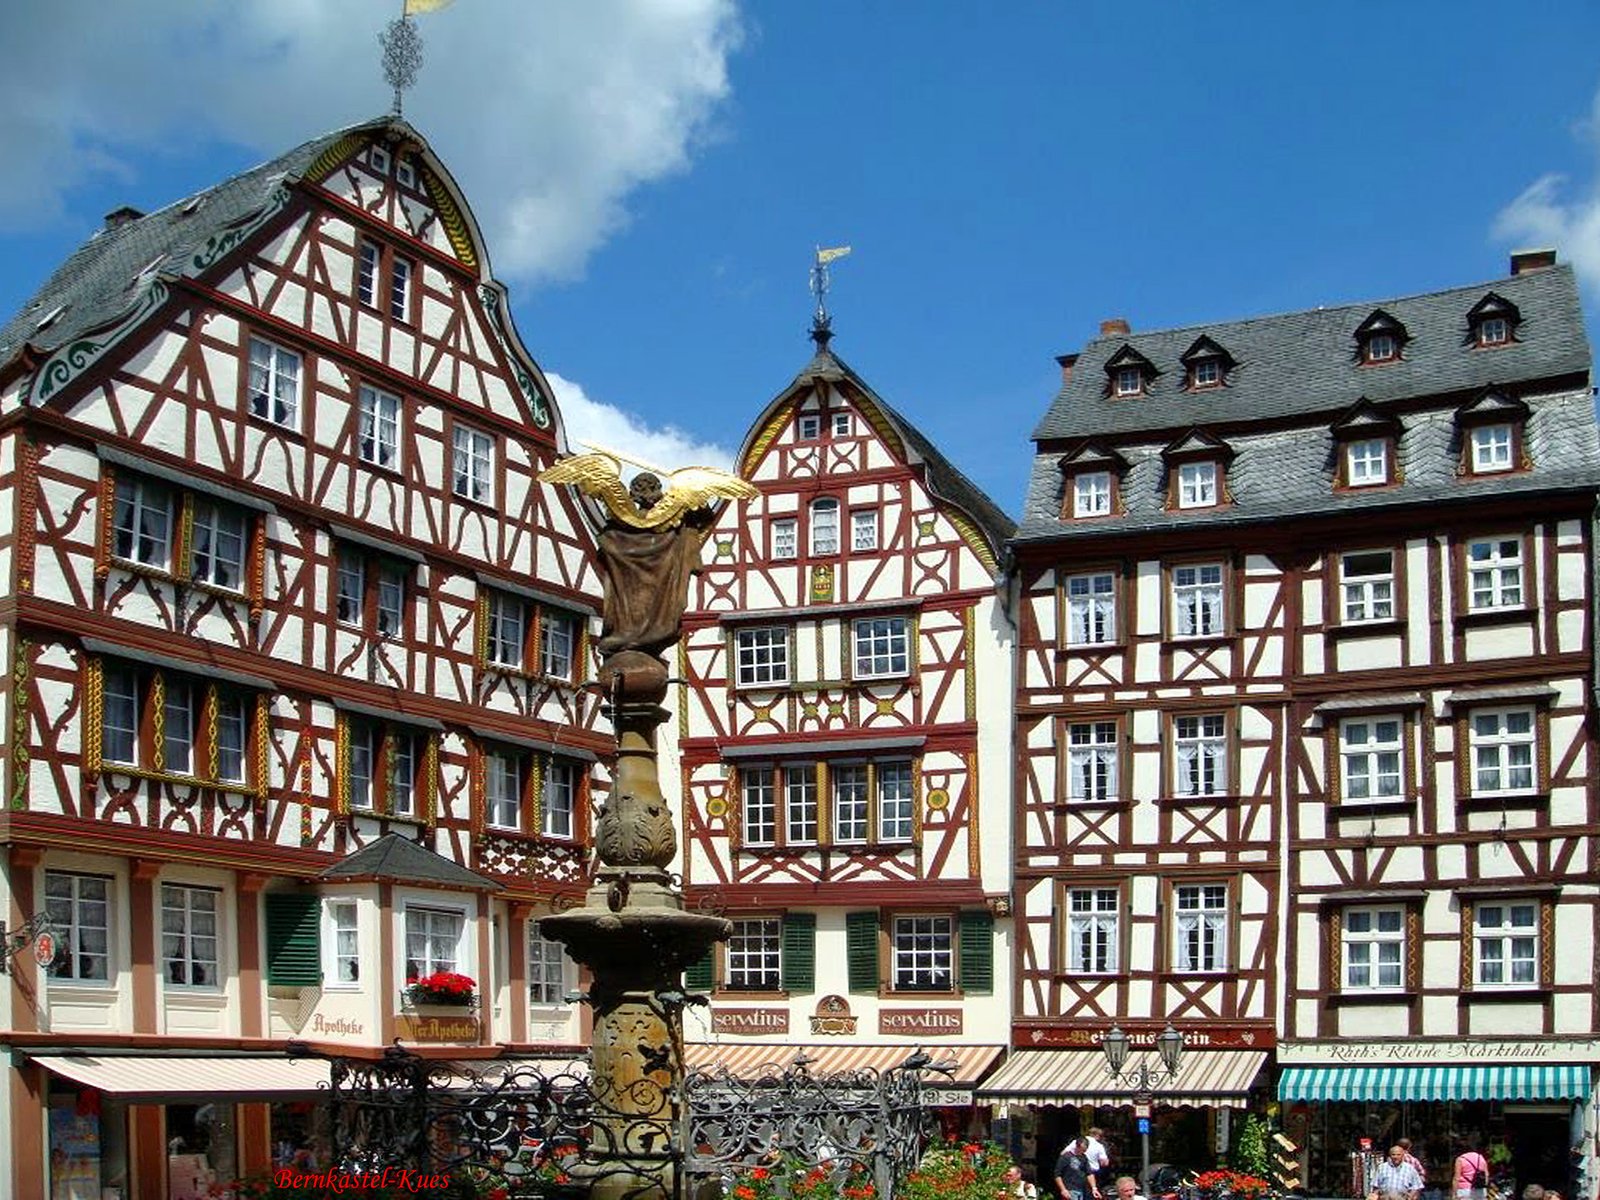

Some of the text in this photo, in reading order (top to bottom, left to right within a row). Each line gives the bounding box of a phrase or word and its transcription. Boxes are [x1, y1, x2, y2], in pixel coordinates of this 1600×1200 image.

[312, 1013, 363, 1036] Apotheke
[881, 1010, 961, 1027] servatius
[1448, 1043, 1550, 1058] Markthalle
[945, 1092, 969, 1104] Sie
